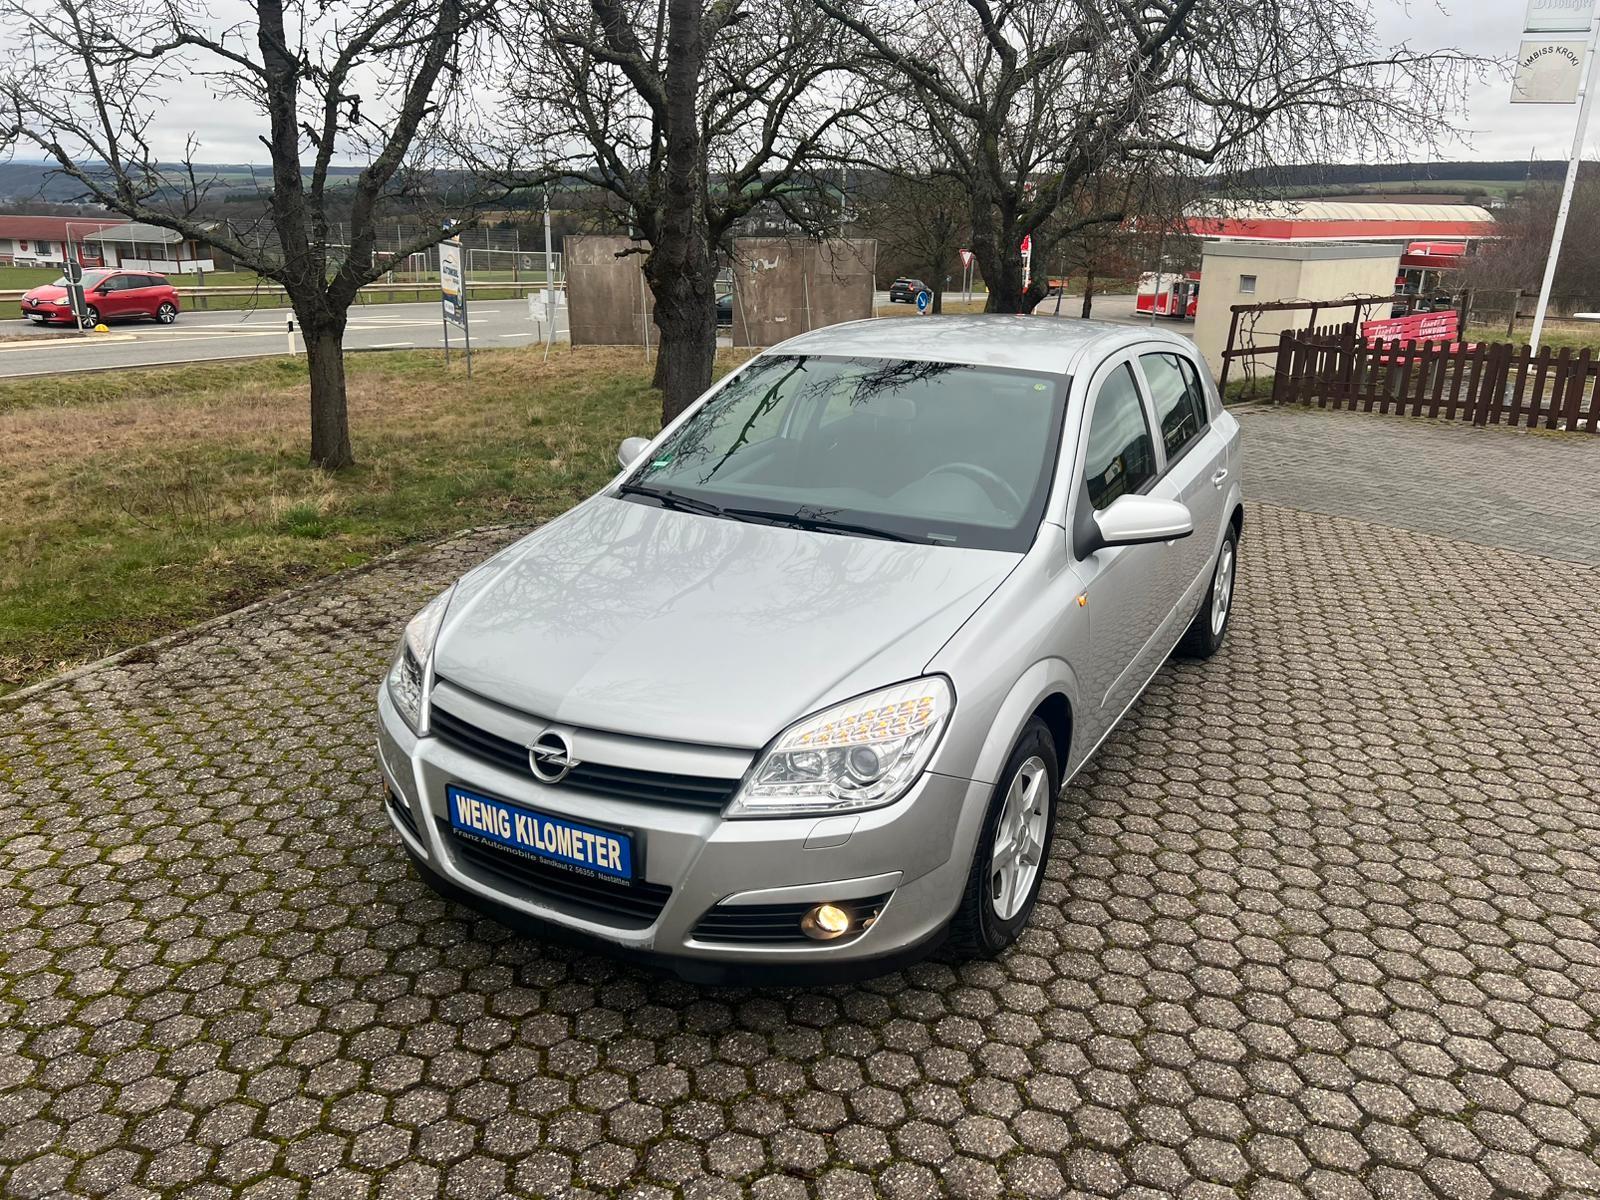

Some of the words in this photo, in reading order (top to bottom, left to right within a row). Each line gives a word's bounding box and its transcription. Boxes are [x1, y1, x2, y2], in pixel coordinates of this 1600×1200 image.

[1524, 46, 1554, 68] IMBISS
[1555, 46, 1580, 67] KROKI
[453, 827, 480, 842] Franz
[481, 837, 537, 861] Automobile
[568, 864, 574, 872] 2
[574, 866, 595, 878] 56355
[456, 794, 511, 839] WENIG
[514, 813, 623, 871] KILOMETER
